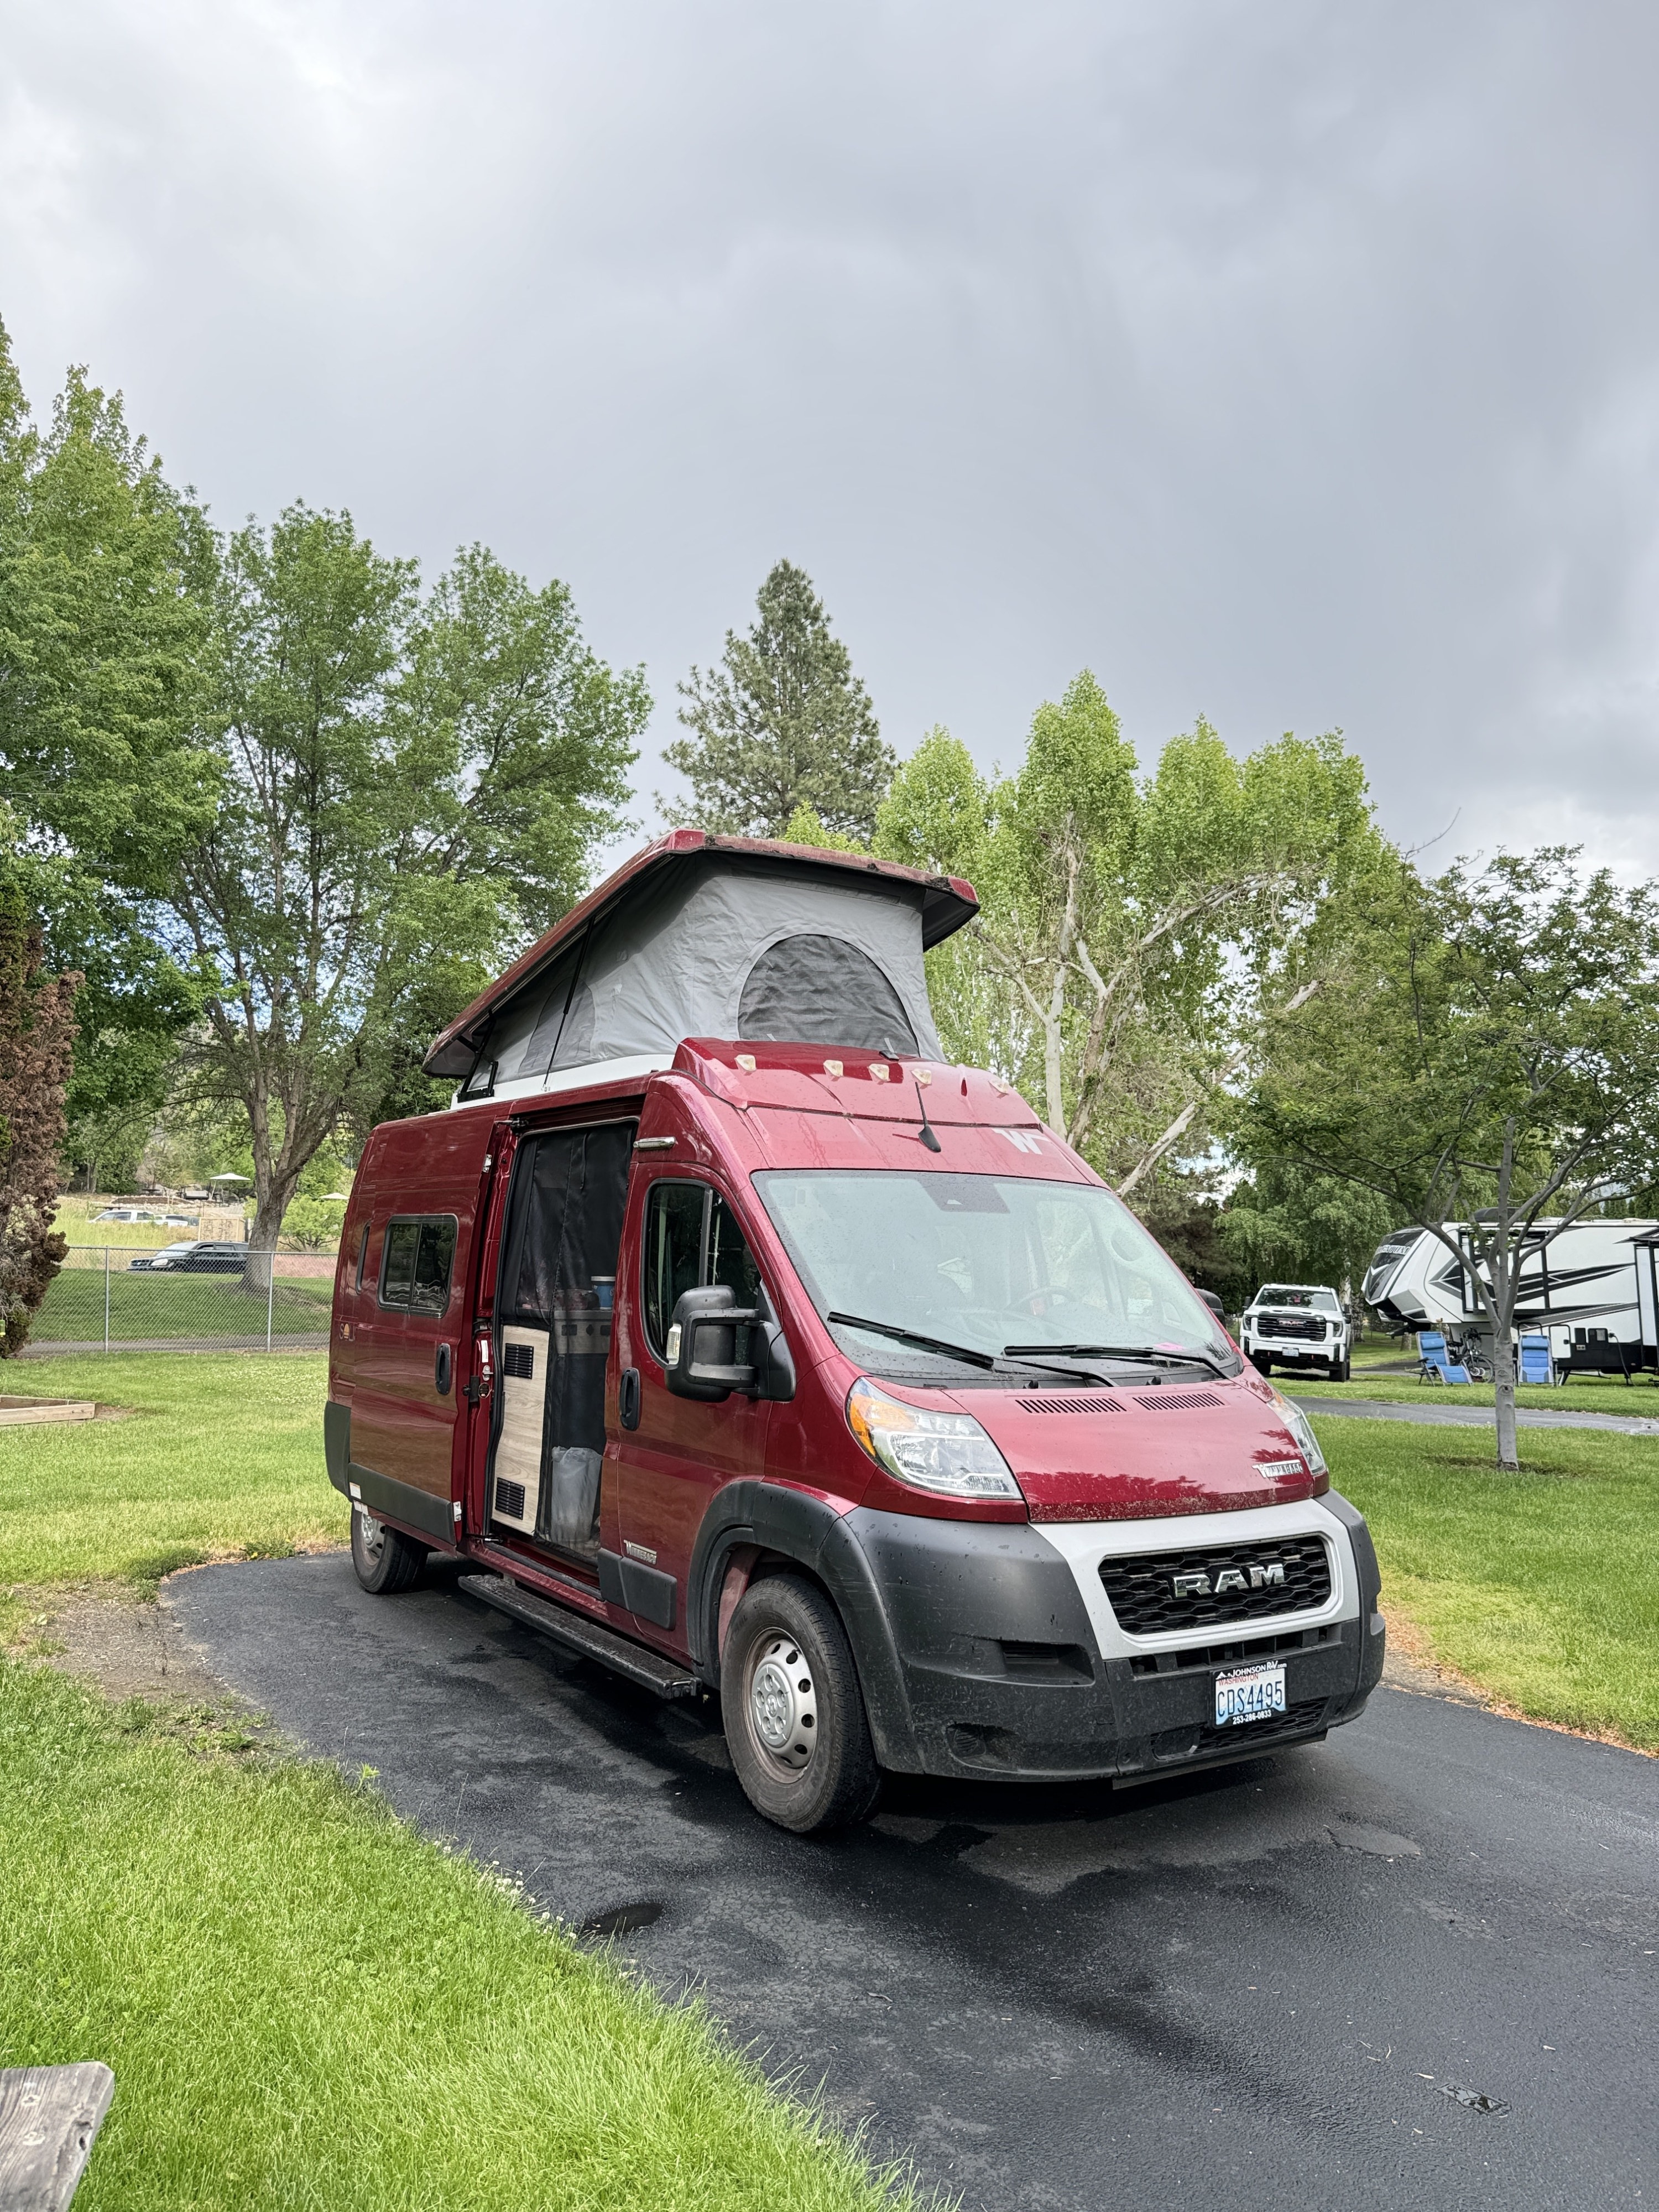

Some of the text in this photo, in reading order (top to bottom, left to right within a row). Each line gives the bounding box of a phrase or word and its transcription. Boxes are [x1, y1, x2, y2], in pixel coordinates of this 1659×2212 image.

[1172, 1563, 1285, 1598] RAM
[1219, 1673, 1259, 1686] WASHINGTON
[1217, 1680, 1282, 1717] CDS4495
[1232, 1709, 1272, 1725] 253-286-0833
